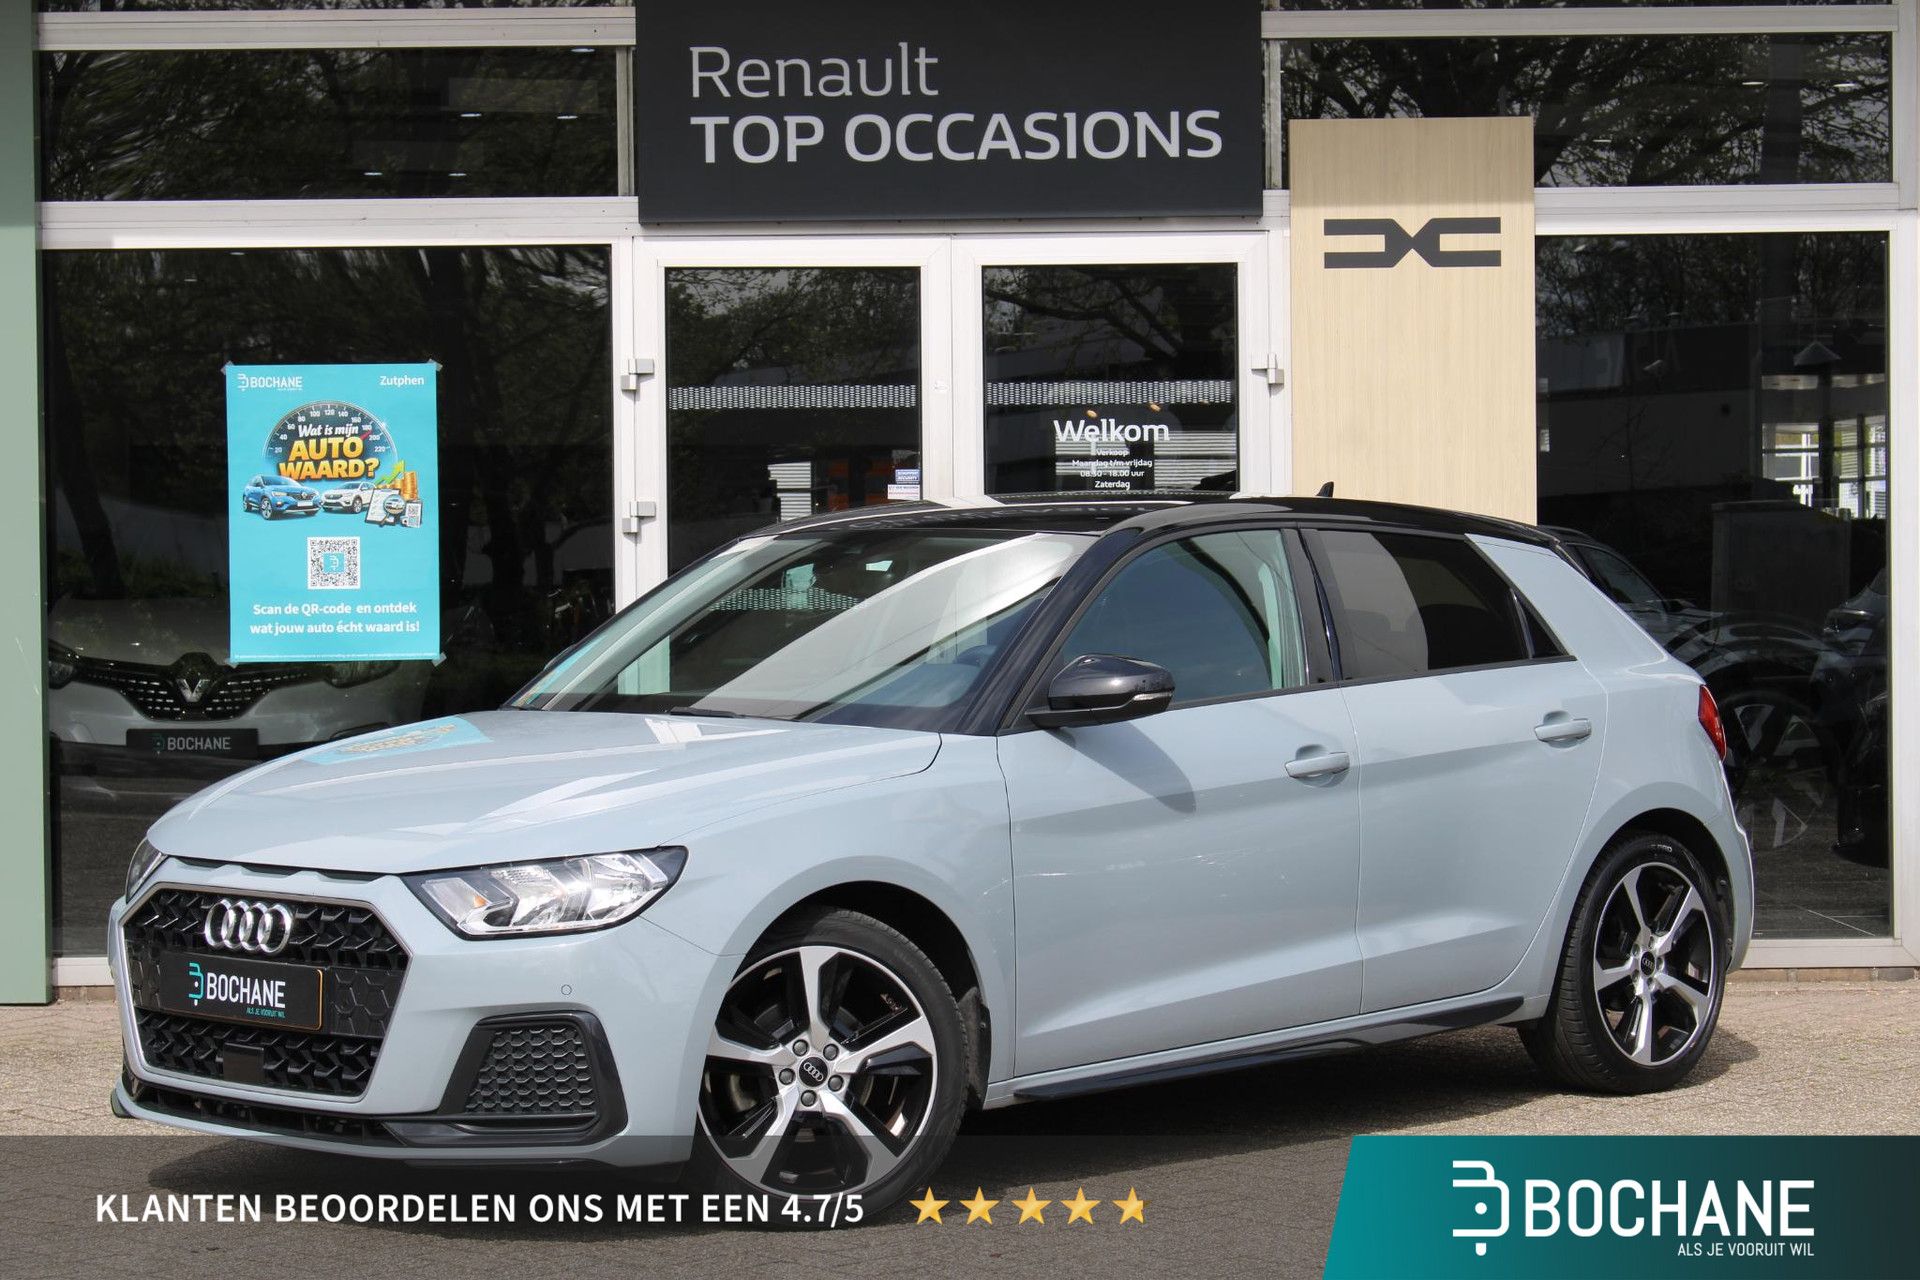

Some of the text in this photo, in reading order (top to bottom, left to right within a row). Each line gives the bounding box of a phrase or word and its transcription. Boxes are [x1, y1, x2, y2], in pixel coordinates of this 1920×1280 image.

[689, 42, 939, 98] Renault
[690, 110, 1223, 163] TOP OCCASIONS
[250, 376, 303, 388] BOCHANE
[379, 375, 425, 386] Zutphen
[298, 423, 359, 438] Wat is mijn
[1053, 419, 1170, 442] Welkom
[288, 436, 363, 461] AUTO
[279, 457, 379, 480] WAARD?
[1126, 459, 1153, 468] vrijdag
[1095, 481, 1131, 491] Zaterdag
[253, 602, 417, 616] Scan de QR-code en ontdek
[250, 620, 420, 636] wat jouw auto écht waard is!
[167, 737, 232, 751] BOCHANE
[206, 972, 286, 1008] BOCHANE
